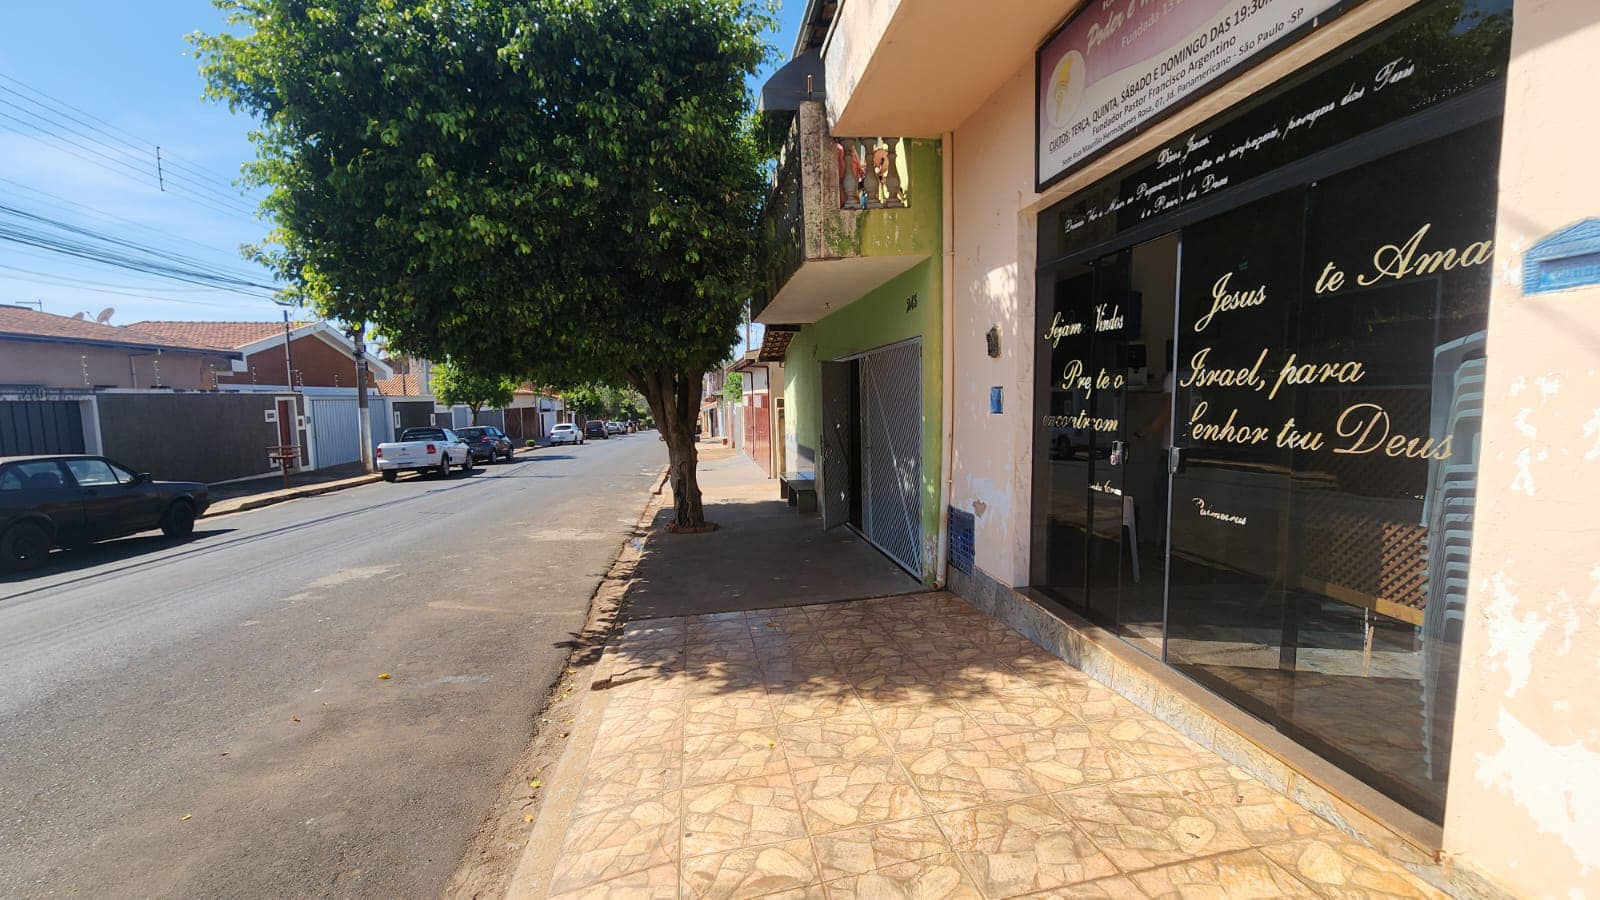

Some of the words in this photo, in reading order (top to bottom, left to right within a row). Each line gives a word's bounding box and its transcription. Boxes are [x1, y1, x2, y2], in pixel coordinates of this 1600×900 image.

[1121, 73, 1151, 103] SÁBADO
[1154, 67, 1159, 81] E
[1160, 34, 1208, 76] DOMINGO
[1210, 17, 1231, 42] DAS
[1234, 0, 1272, 26] 19:30
[1177, 55, 1231, 93] Panamericano
[1239, 39, 1255, 56] São
[1257, 21, 1284, 44] Paulo
[1340, 81, 1365, 106] dos
[1373, 56, 1415, 91] Tais
[1092, 110, 1122, 136] Fundador
[1124, 95, 1147, 116] Pastor
[1149, 69, 1186, 100] Francisco
[1188, 36, 1236, 72] Argentino
[1201, 174, 1228, 194] Deus
[1194, 271, 1266, 332] Jesus
[1315, 261, 1345, 294] te
[1357, 223, 1495, 287] Ama
[1044, 311, 1082, 349] Sejam
[1094, 303, 1124, 332] Vindos
[1179, 348, 1268, 391] Israel,
[1269, 354, 1366, 400] para
[1185, 401, 1268, 445] Senhor
[1276, 417, 1325, 451] teu
[1333, 403, 1453, 461] Deus
